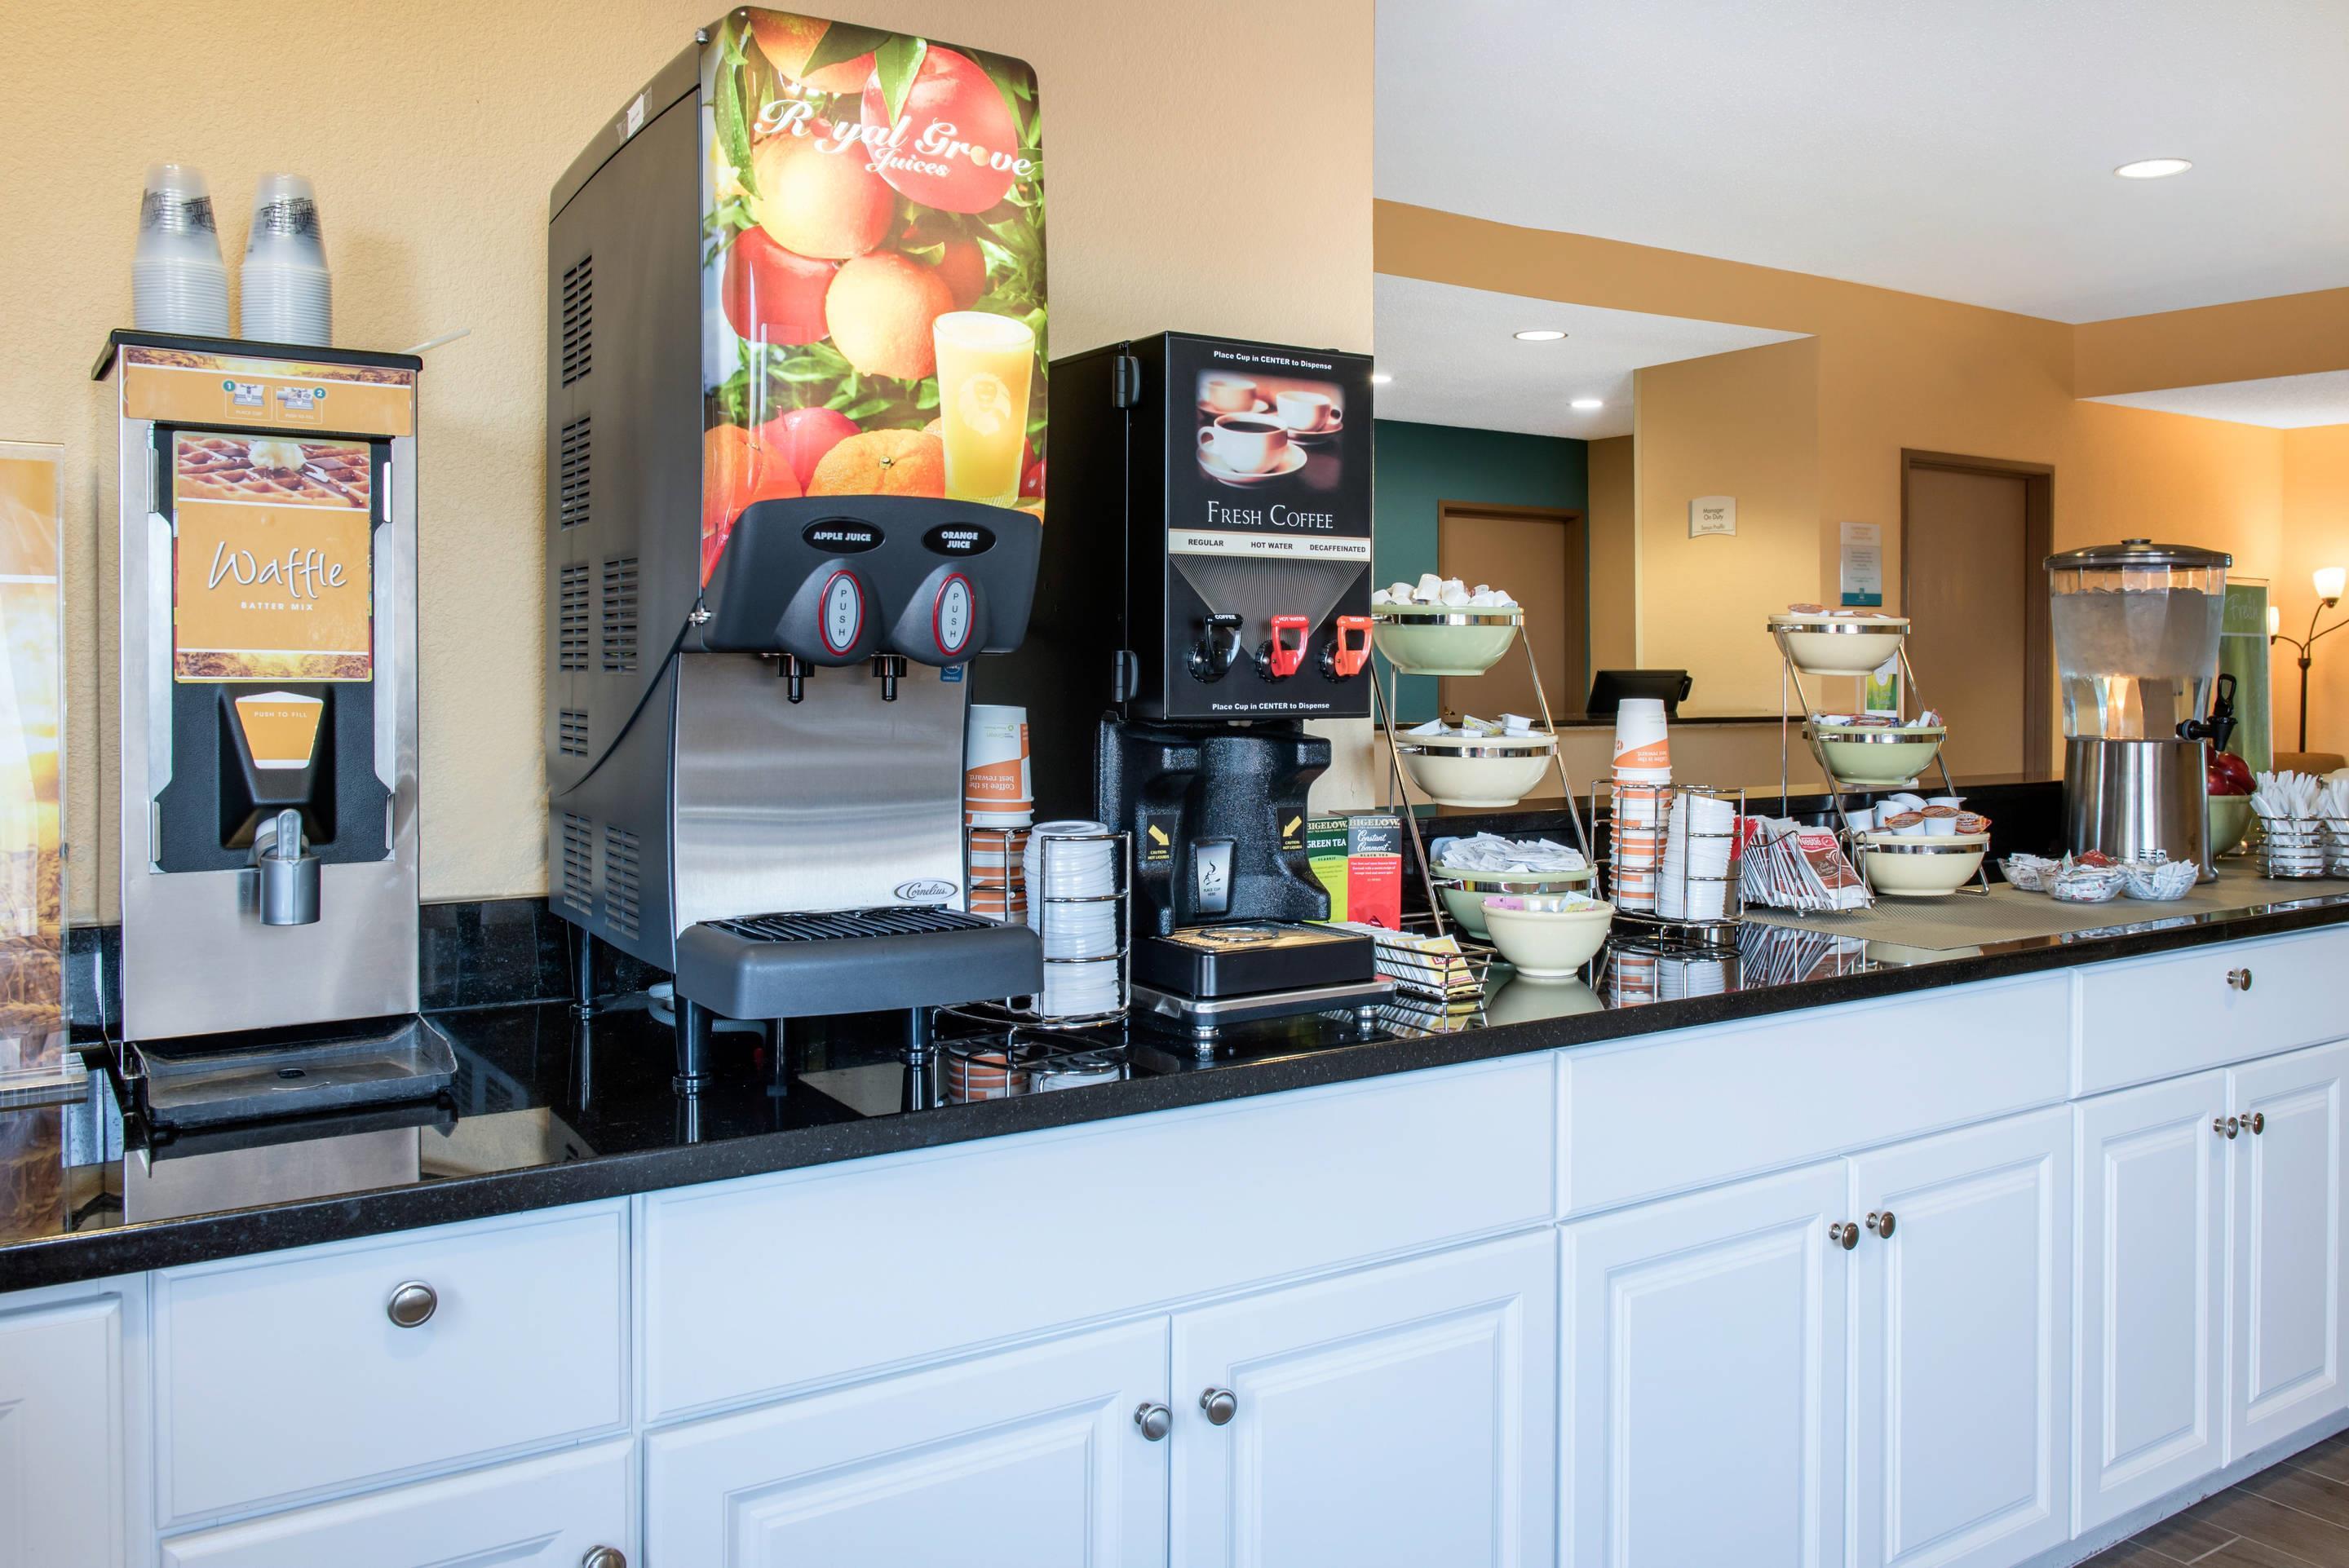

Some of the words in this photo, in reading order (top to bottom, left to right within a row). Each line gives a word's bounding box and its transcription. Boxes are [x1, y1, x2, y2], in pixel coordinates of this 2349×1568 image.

[865, 148, 950, 178] Juices
[1214, 351, 1234, 359] Place
[1260, 356, 1290, 365] CENTER
[1300, 360, 1332, 369] Dispense
[1208, 501, 1262, 525] FRESH
[1270, 505, 1334, 528] COFFEE
[813, 532, 843, 540] APPLE
[845, 532, 871, 541] JUICE
[941, 531, 978, 540] ORANGE
[947, 541, 971, 549] JUICE
[1188, 538, 1223, 547] REGULAR
[1310, 544, 1365, 553] DECAFFEINATED
[208, 541, 347, 599] Waffle
[241, 602, 284, 610] BATTER
[290, 603, 313, 611] MIX
[838, 590, 847, 637] PUSH
[949, 593, 959, 638] PUSH
[1235, 703, 1249, 711] Cup
[990, 783, 1015, 791] Coffee
[1307, 839, 1331, 848] GREEN
